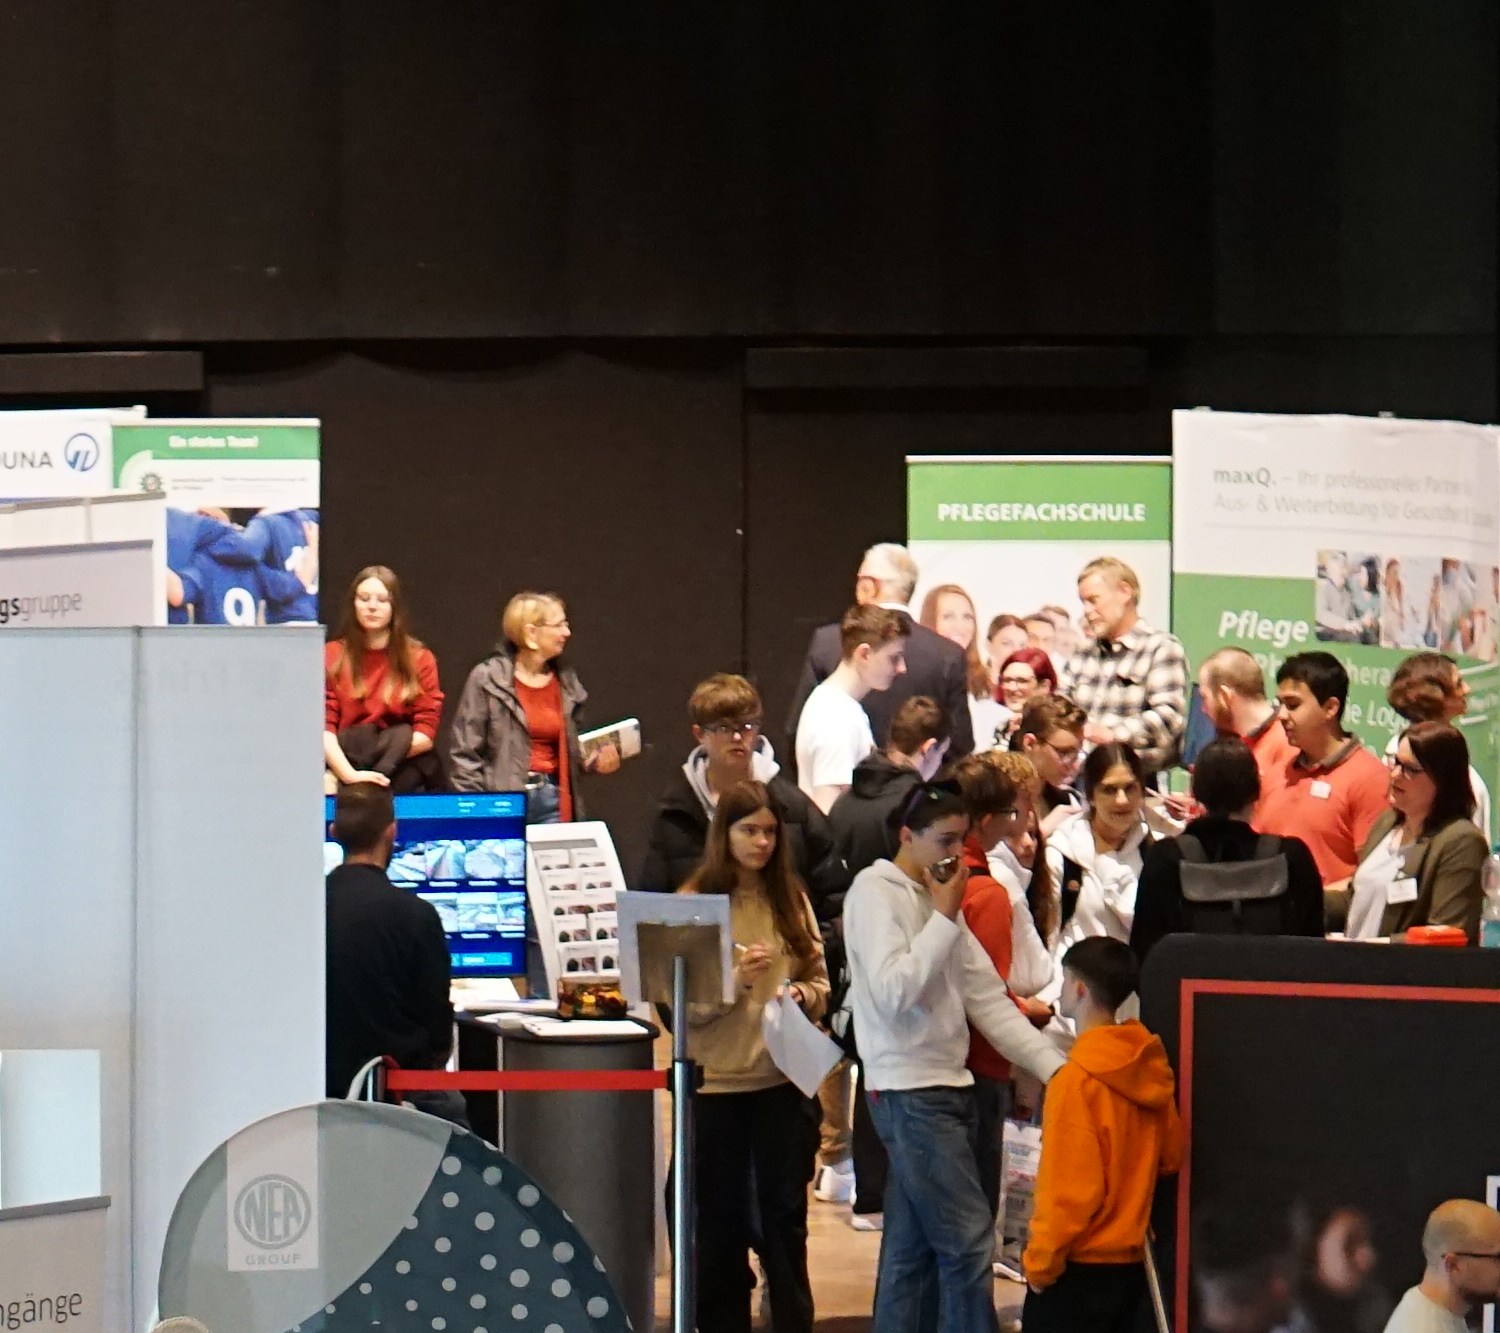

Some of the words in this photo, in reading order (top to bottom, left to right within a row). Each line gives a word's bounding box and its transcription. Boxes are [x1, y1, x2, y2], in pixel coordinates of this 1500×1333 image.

[937, 501, 1147, 523] PFLEGEFACHSCHULE
[1218, 610, 1311, 650] Pflege
[245, 1183, 302, 1242] NEA
